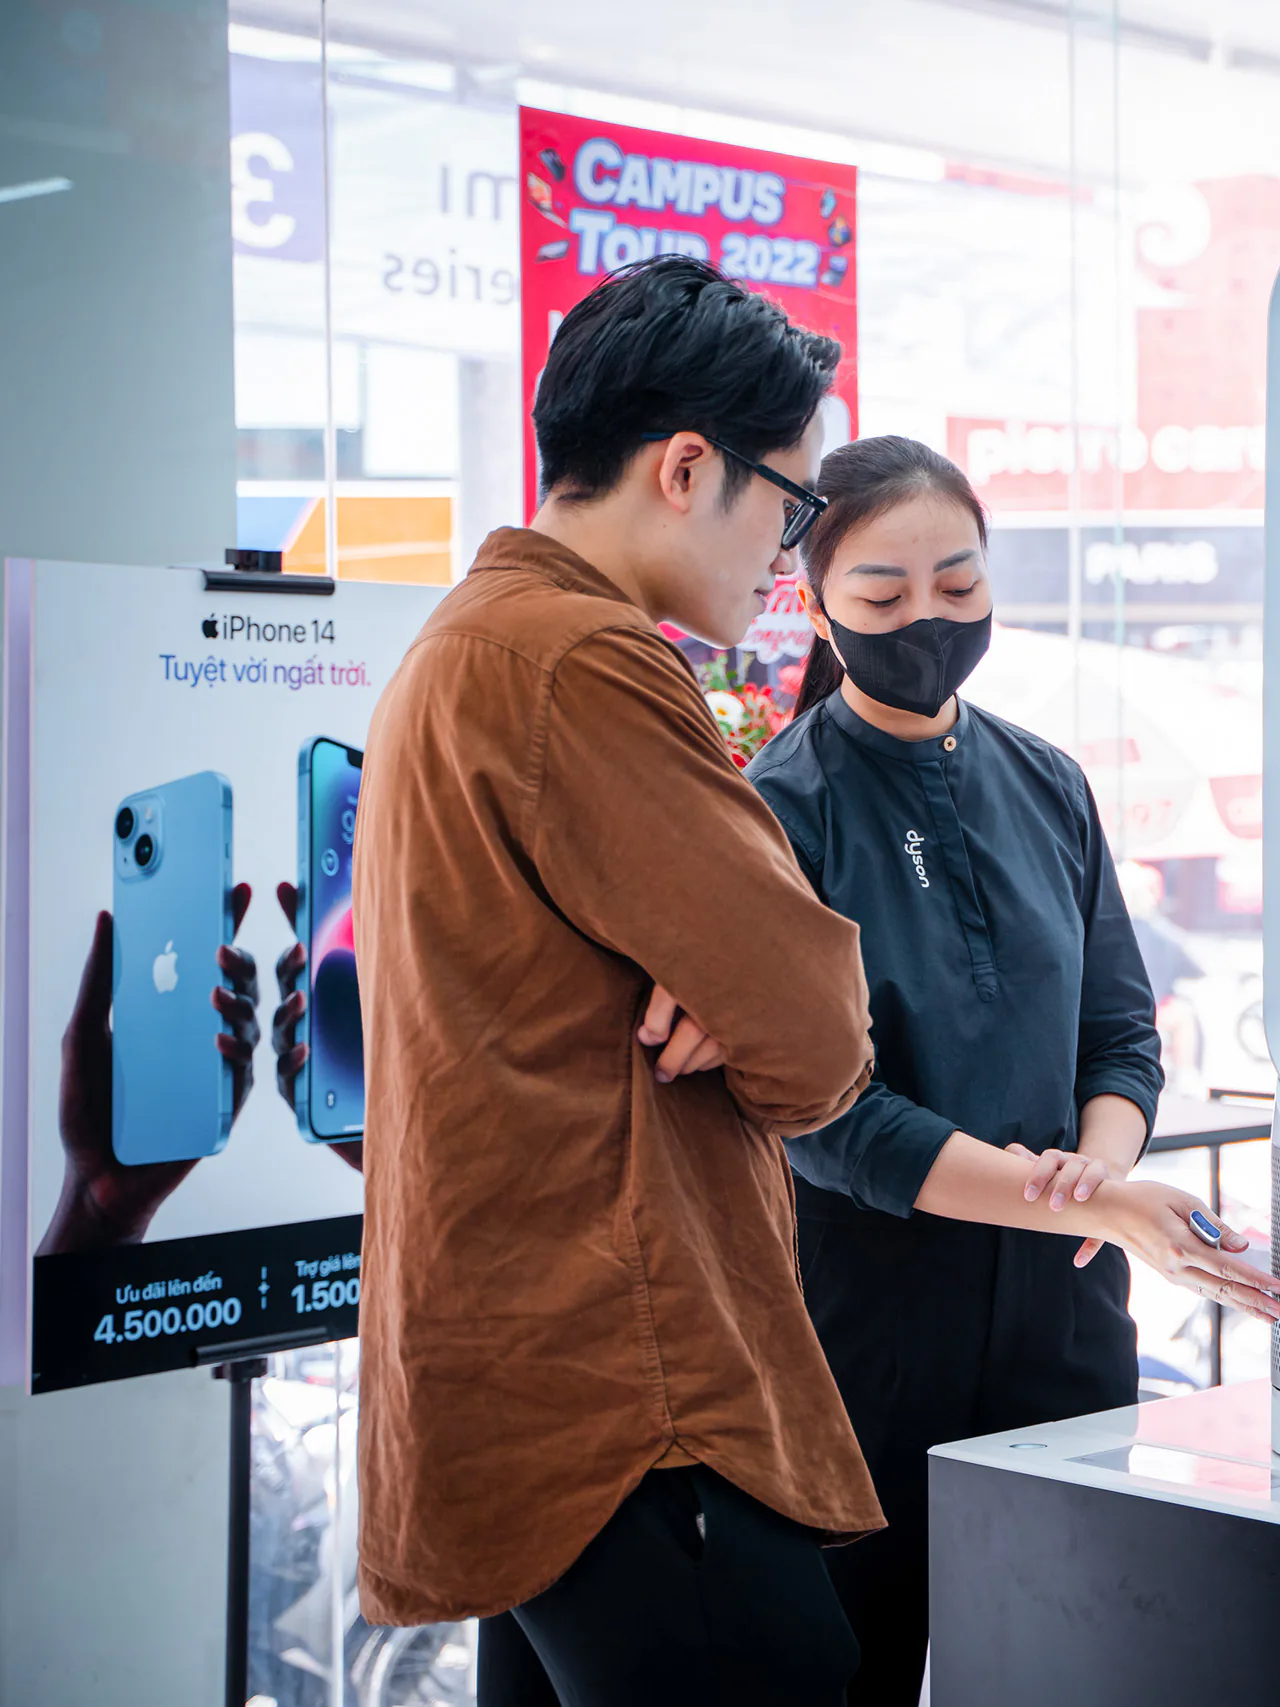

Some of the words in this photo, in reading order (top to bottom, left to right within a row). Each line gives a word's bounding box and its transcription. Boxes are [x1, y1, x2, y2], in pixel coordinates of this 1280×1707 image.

[574, 138, 785, 226] CAMPUS
[720, 232, 821, 288] 2022
[222, 615, 307, 643] iPhone
[311, 619, 336, 644] 14
[159, 654, 227, 688] Tuyệt
[232, 656, 268, 683] vời
[273, 655, 325, 690] ngất
[330, 660, 372, 687] trời.
[904, 830, 930, 888] dyson
[116, 1284, 140, 1305] Ưu
[168, 1279, 191, 1297] lên
[193, 1270, 223, 1294] đến
[94, 1297, 242, 1345] 4.500.000
